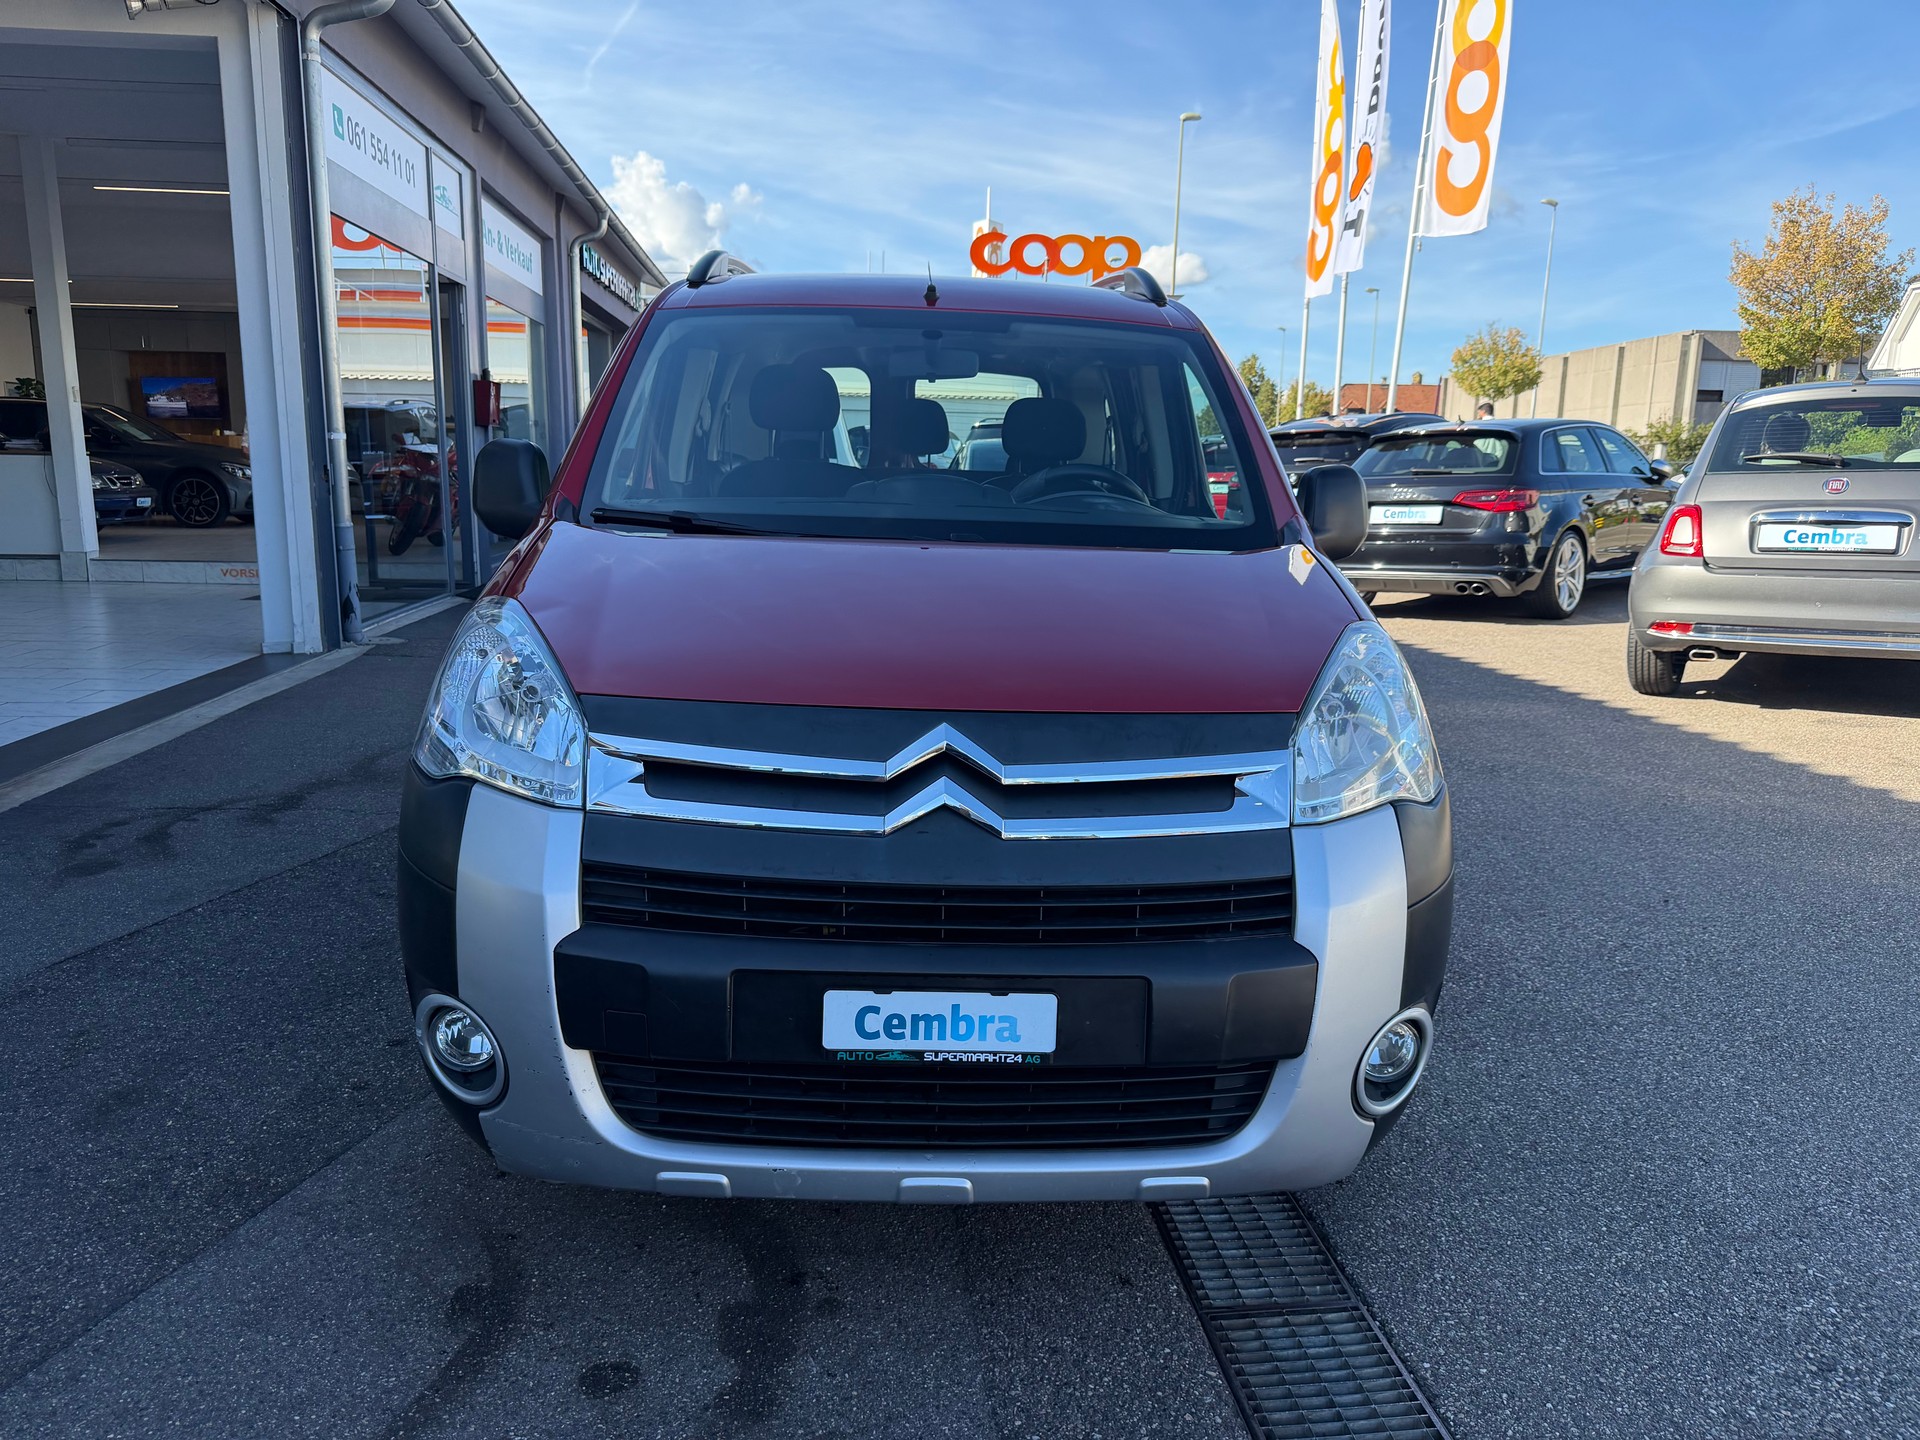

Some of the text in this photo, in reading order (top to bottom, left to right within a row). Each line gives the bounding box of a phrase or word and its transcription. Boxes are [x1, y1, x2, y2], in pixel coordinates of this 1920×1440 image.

[346, 115, 416, 188] 061 554 11 01
[497, 229, 504, 255] &
[504, 234, 533, 275] Verkauf
[969, 231, 1142, 282] coop
[1828, 480, 1844, 490] FIAT
[1383, 507, 1426, 519] Cembra
[1783, 528, 1868, 545] Cembra
[854, 1003, 1022, 1043] Cembra
[837, 1051, 1041, 1064] AUTO SUPERMARKT24 AG
